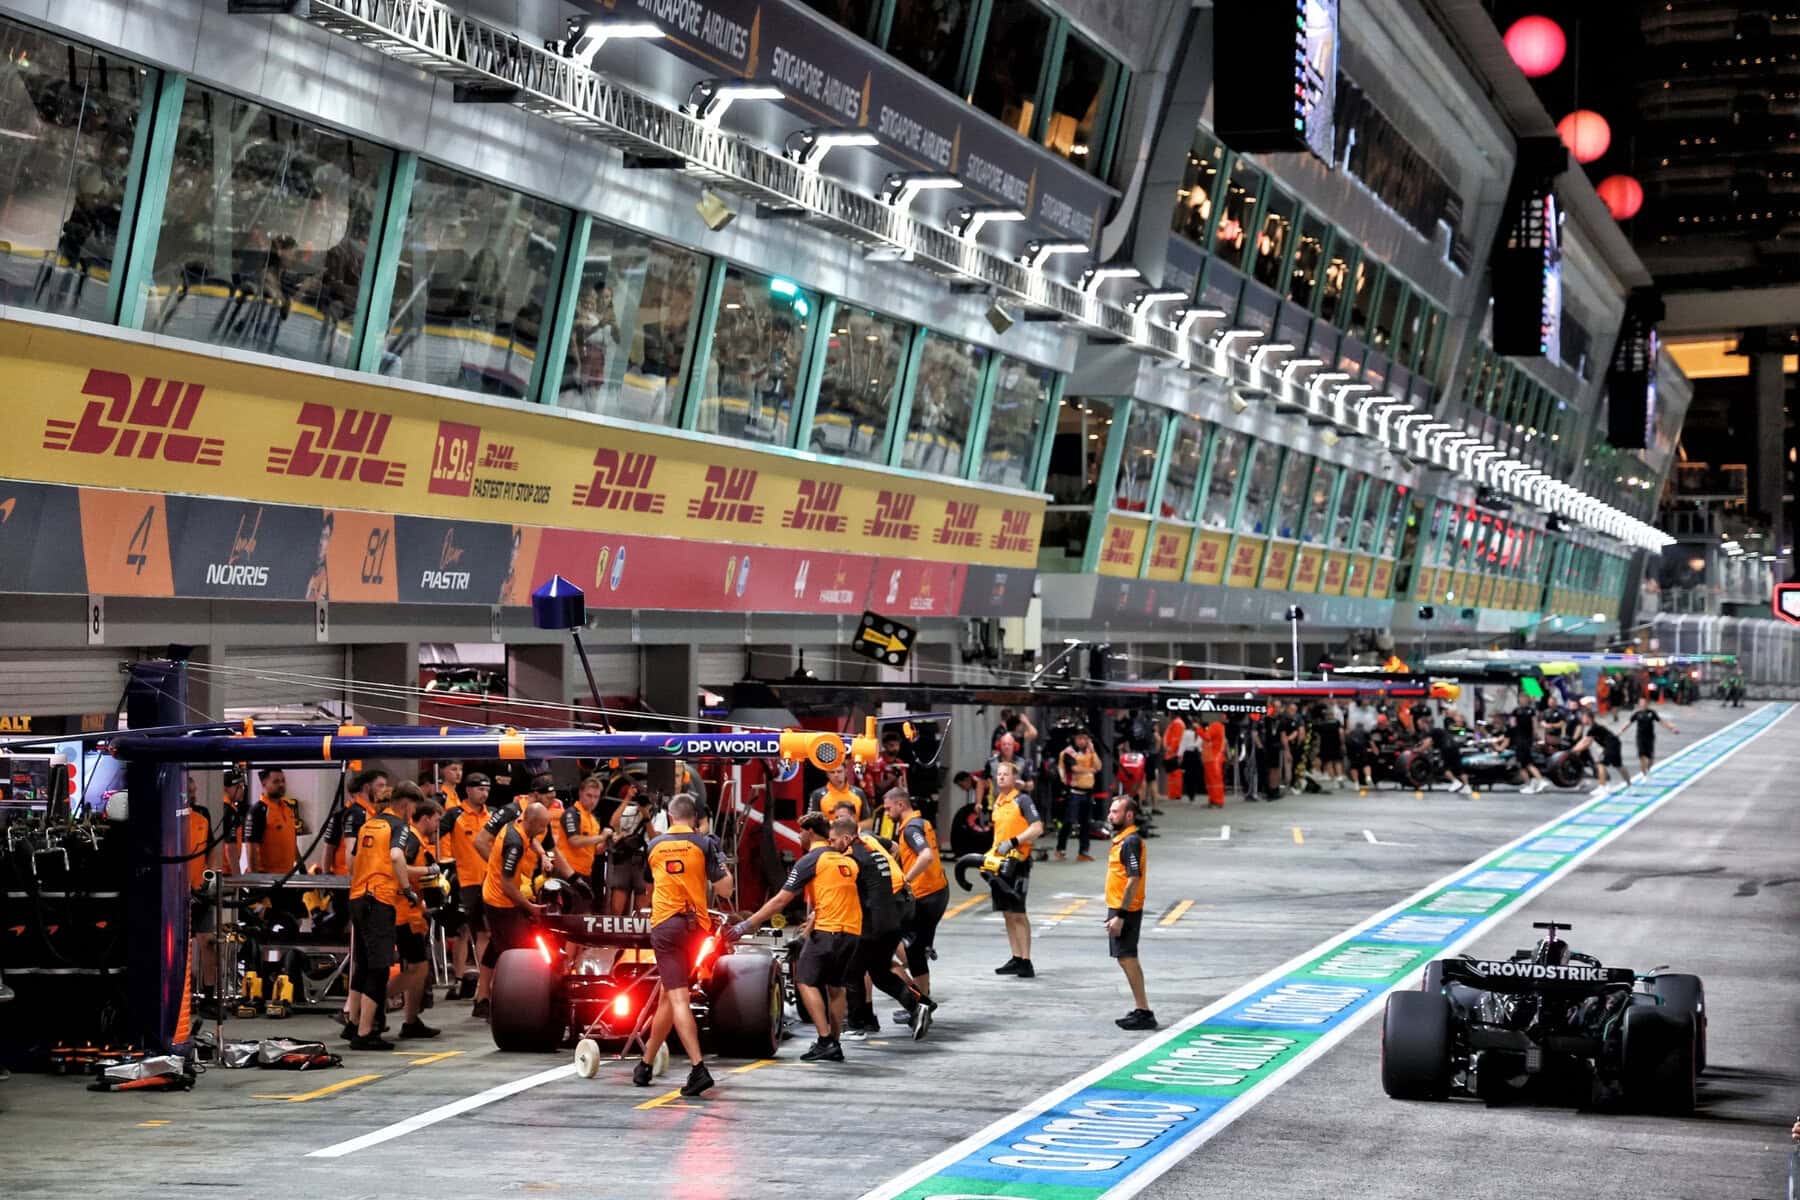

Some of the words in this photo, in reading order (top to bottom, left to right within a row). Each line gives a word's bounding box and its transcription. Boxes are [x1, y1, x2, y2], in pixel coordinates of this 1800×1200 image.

[700, 9, 749, 59] AIRLINES
[771, 47, 824, 99] SINGAPORE
[67, 367, 207, 464] DHL
[284, 401, 393, 485] DHL
[484, 443, 515, 471] DHL
[472, 478, 505, 499] FASTEST
[503, 481, 517, 500] PIT
[515, 483, 535, 502] STOP
[533, 485, 552, 504] 2025
[583, 447, 659, 513] DHL
[696, 464, 759, 523] DHL
[790, 479, 843, 533] DHL
[869, 490, 917, 540] DHL
[939, 500, 981, 548] DHL
[997, 509, 1032, 552] DHL
[126, 505, 155, 576] 4
[361, 527, 390, 585] 81
[206, 563, 270, 586] NORRIS
[420, 570, 471, 590] PIASTRI
[93, 605, 99, 635] 8
[319, 607, 326, 633] 9
[1216, 704, 1268, 714] LOGISTICS
[687, 740, 712, 753] DP
[715, 740, 780, 753] WORLD
[1476, 961, 1609, 981] CROWDSTRIKE
[1130, 1032, 1299, 1087] aramco
[987, 1099, 1201, 1172] aramco
